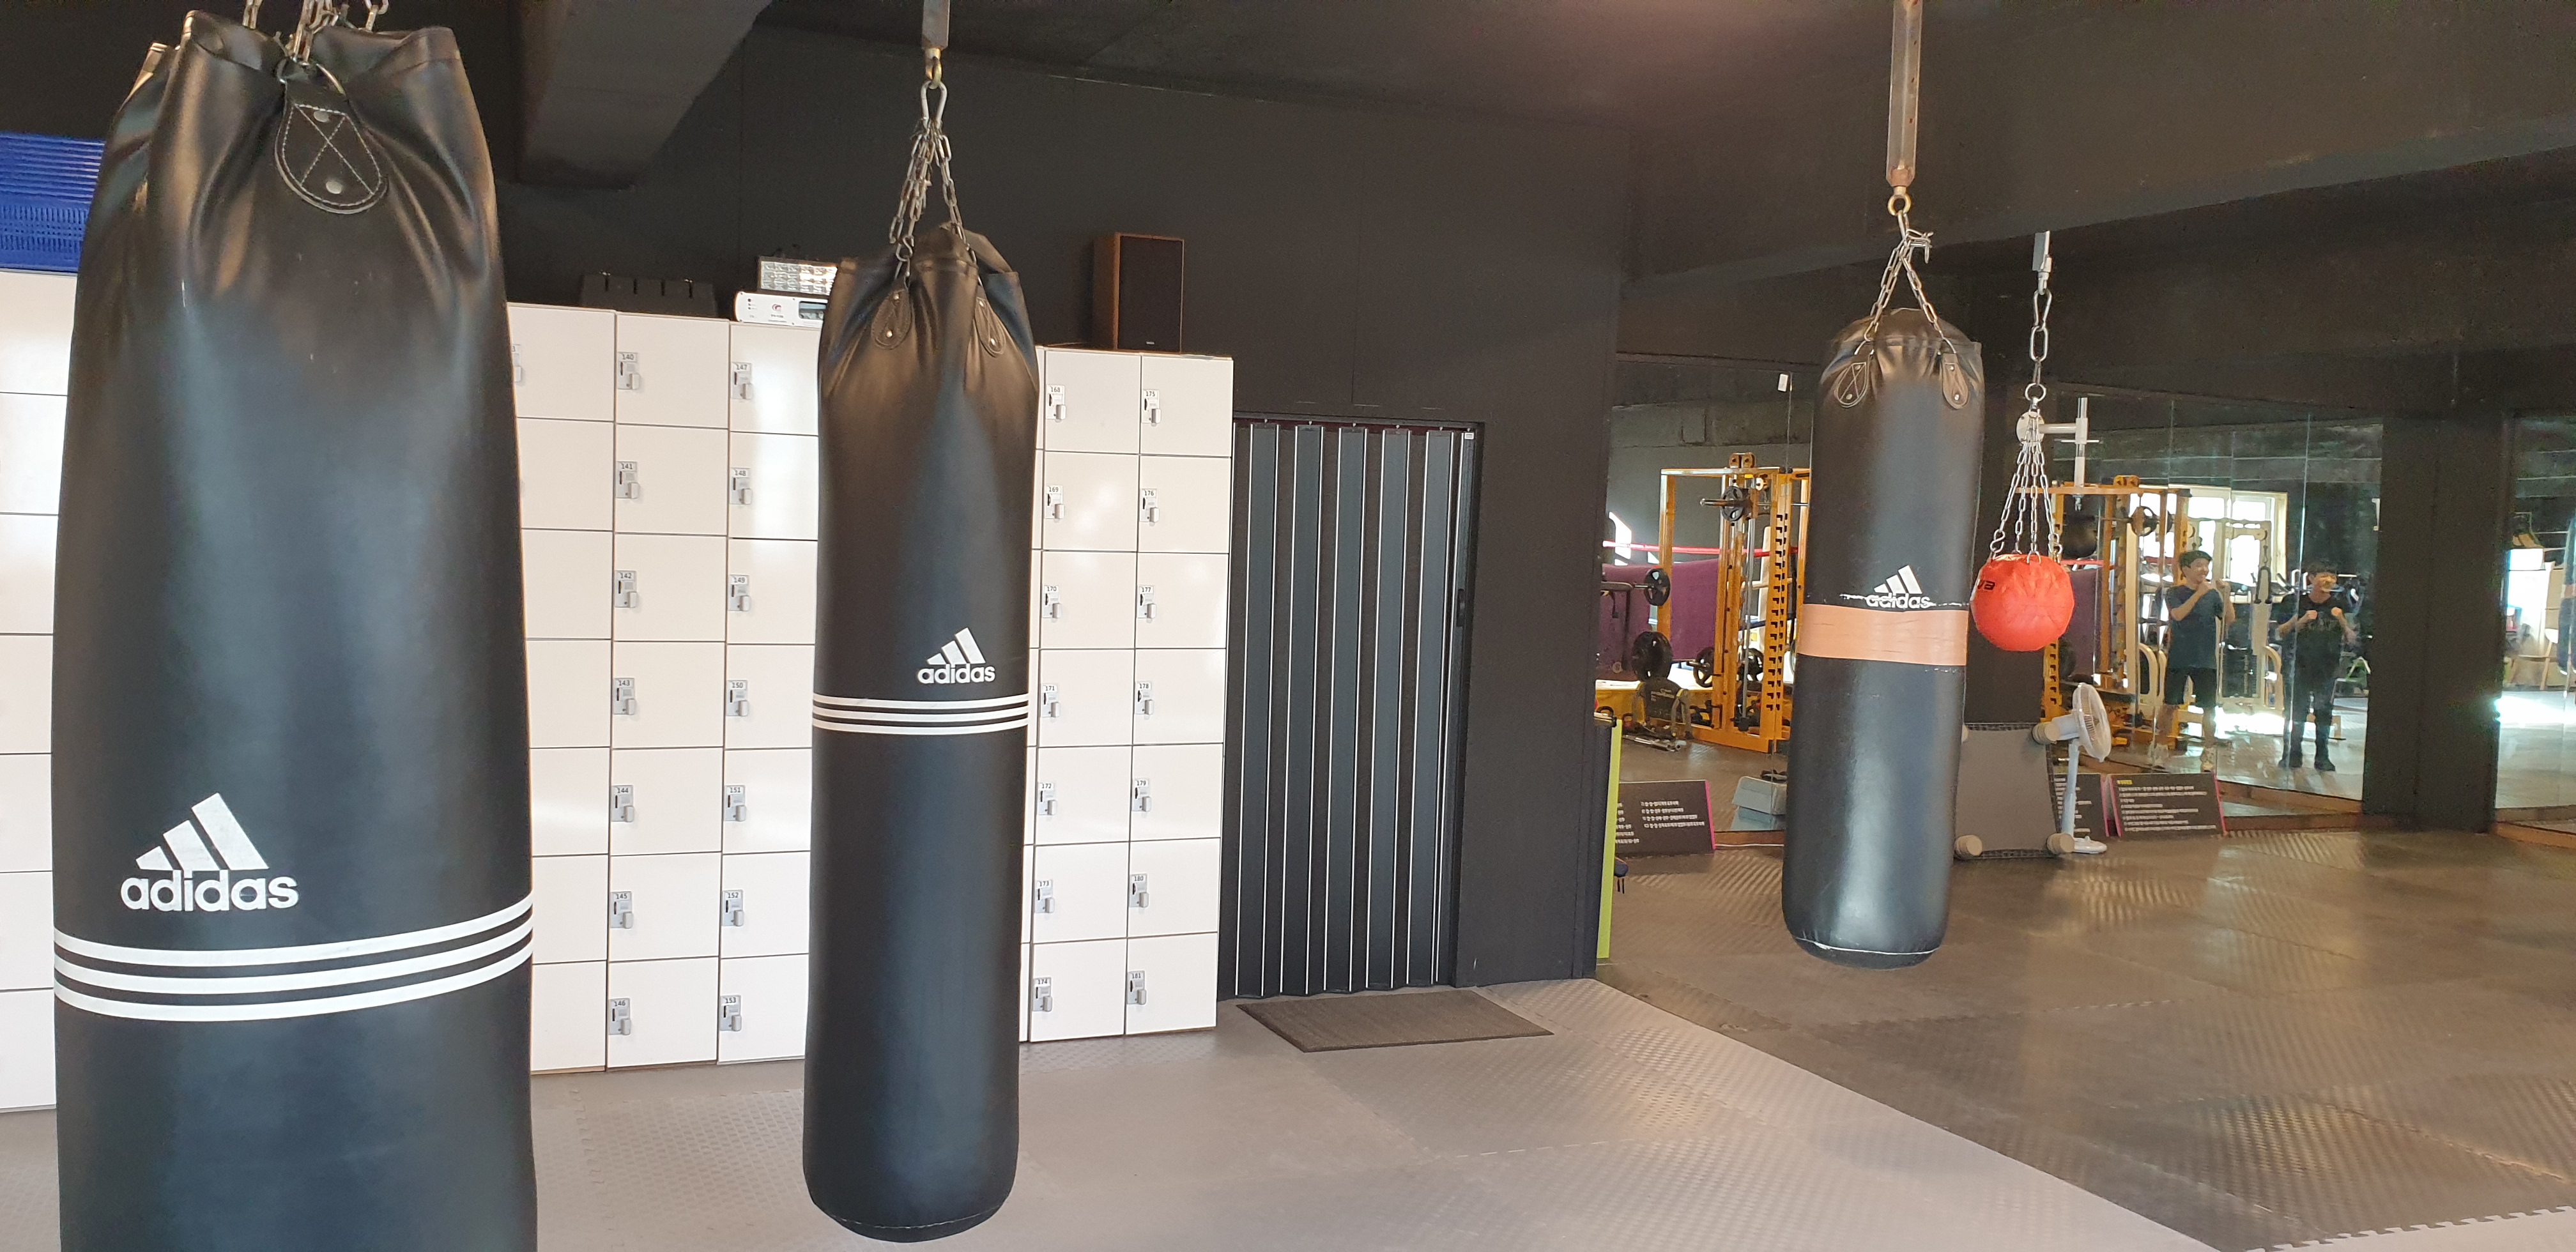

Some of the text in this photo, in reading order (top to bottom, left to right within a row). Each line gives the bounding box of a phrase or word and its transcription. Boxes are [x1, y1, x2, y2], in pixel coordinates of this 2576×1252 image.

[1866, 592, 1931, 609] adidas
[917, 663, 996, 684] adidas
[121, 870, 299, 912] adidas
